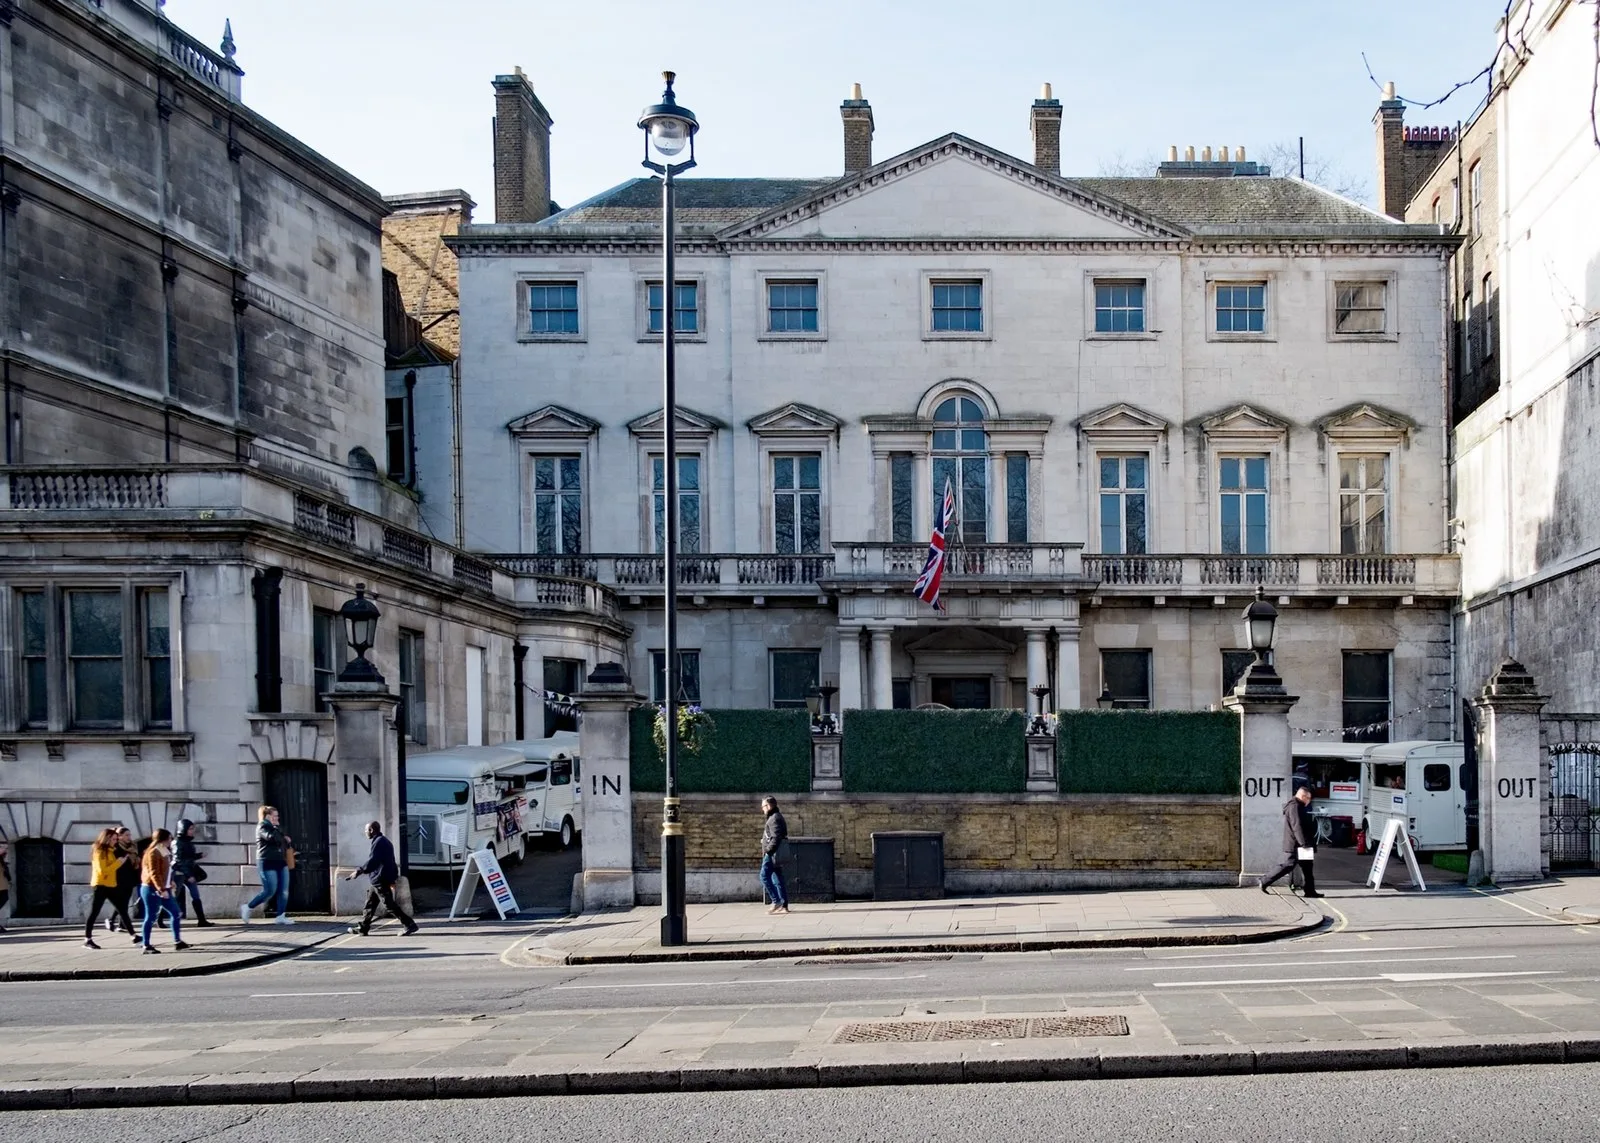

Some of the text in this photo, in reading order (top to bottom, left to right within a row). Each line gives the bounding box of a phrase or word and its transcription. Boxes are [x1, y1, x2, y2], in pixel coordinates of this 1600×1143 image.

[343, 773, 372, 795] IN
[592, 774, 621, 796] IN
[1244, 777, 1285, 798] OUT
[1497, 777, 1537, 799] OUT
